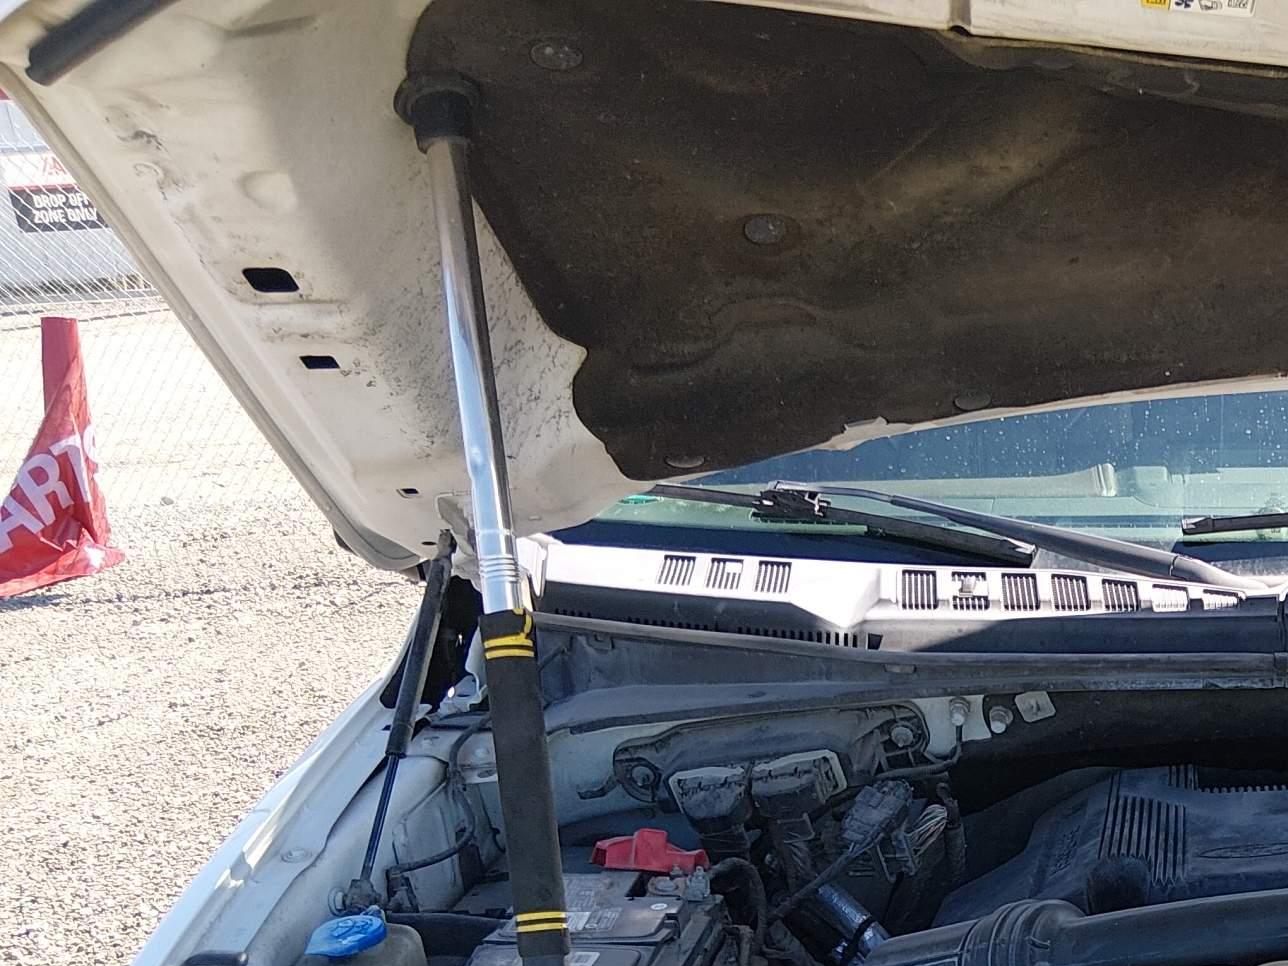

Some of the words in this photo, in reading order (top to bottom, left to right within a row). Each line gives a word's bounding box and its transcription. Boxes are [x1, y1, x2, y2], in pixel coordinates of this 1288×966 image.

[33, 193, 66, 208] DROP
[33, 209, 66, 223] ZONE
[67, 207, 97, 221] ONLY
